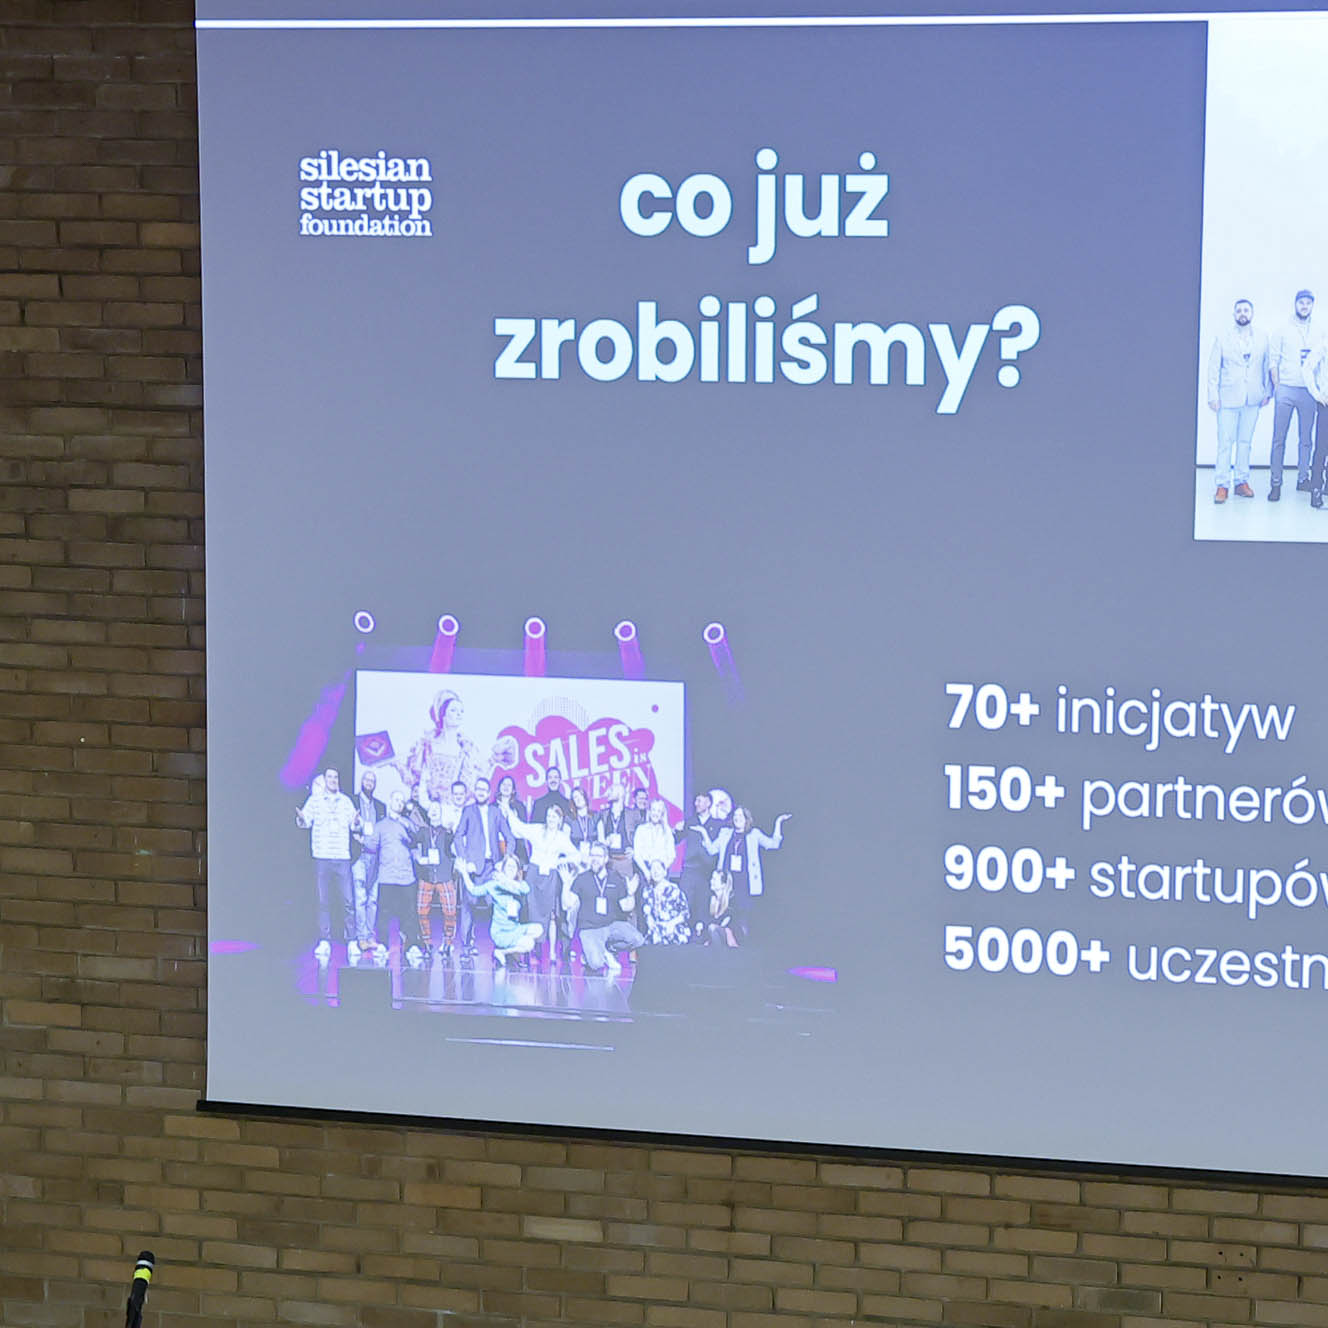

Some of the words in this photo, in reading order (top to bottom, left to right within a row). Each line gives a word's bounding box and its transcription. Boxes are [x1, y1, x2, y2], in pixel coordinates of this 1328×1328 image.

[300, 150, 432, 182] silesian
[299, 212, 433, 237] foundation
[300, 180, 432, 220] startup
[620, 173, 732, 237] co
[748, 148, 888, 264] już
[495, 293, 1041, 414] zrobiliśmy?
[945, 683, 1040, 730] 70+
[1057, 685, 1296, 754] inicjatyw
[524, 723, 632, 788] SALES
[944, 764, 1065, 812] 150+
[944, 844, 1076, 893] 900+
[944, 925, 1110, 976] 5000+
